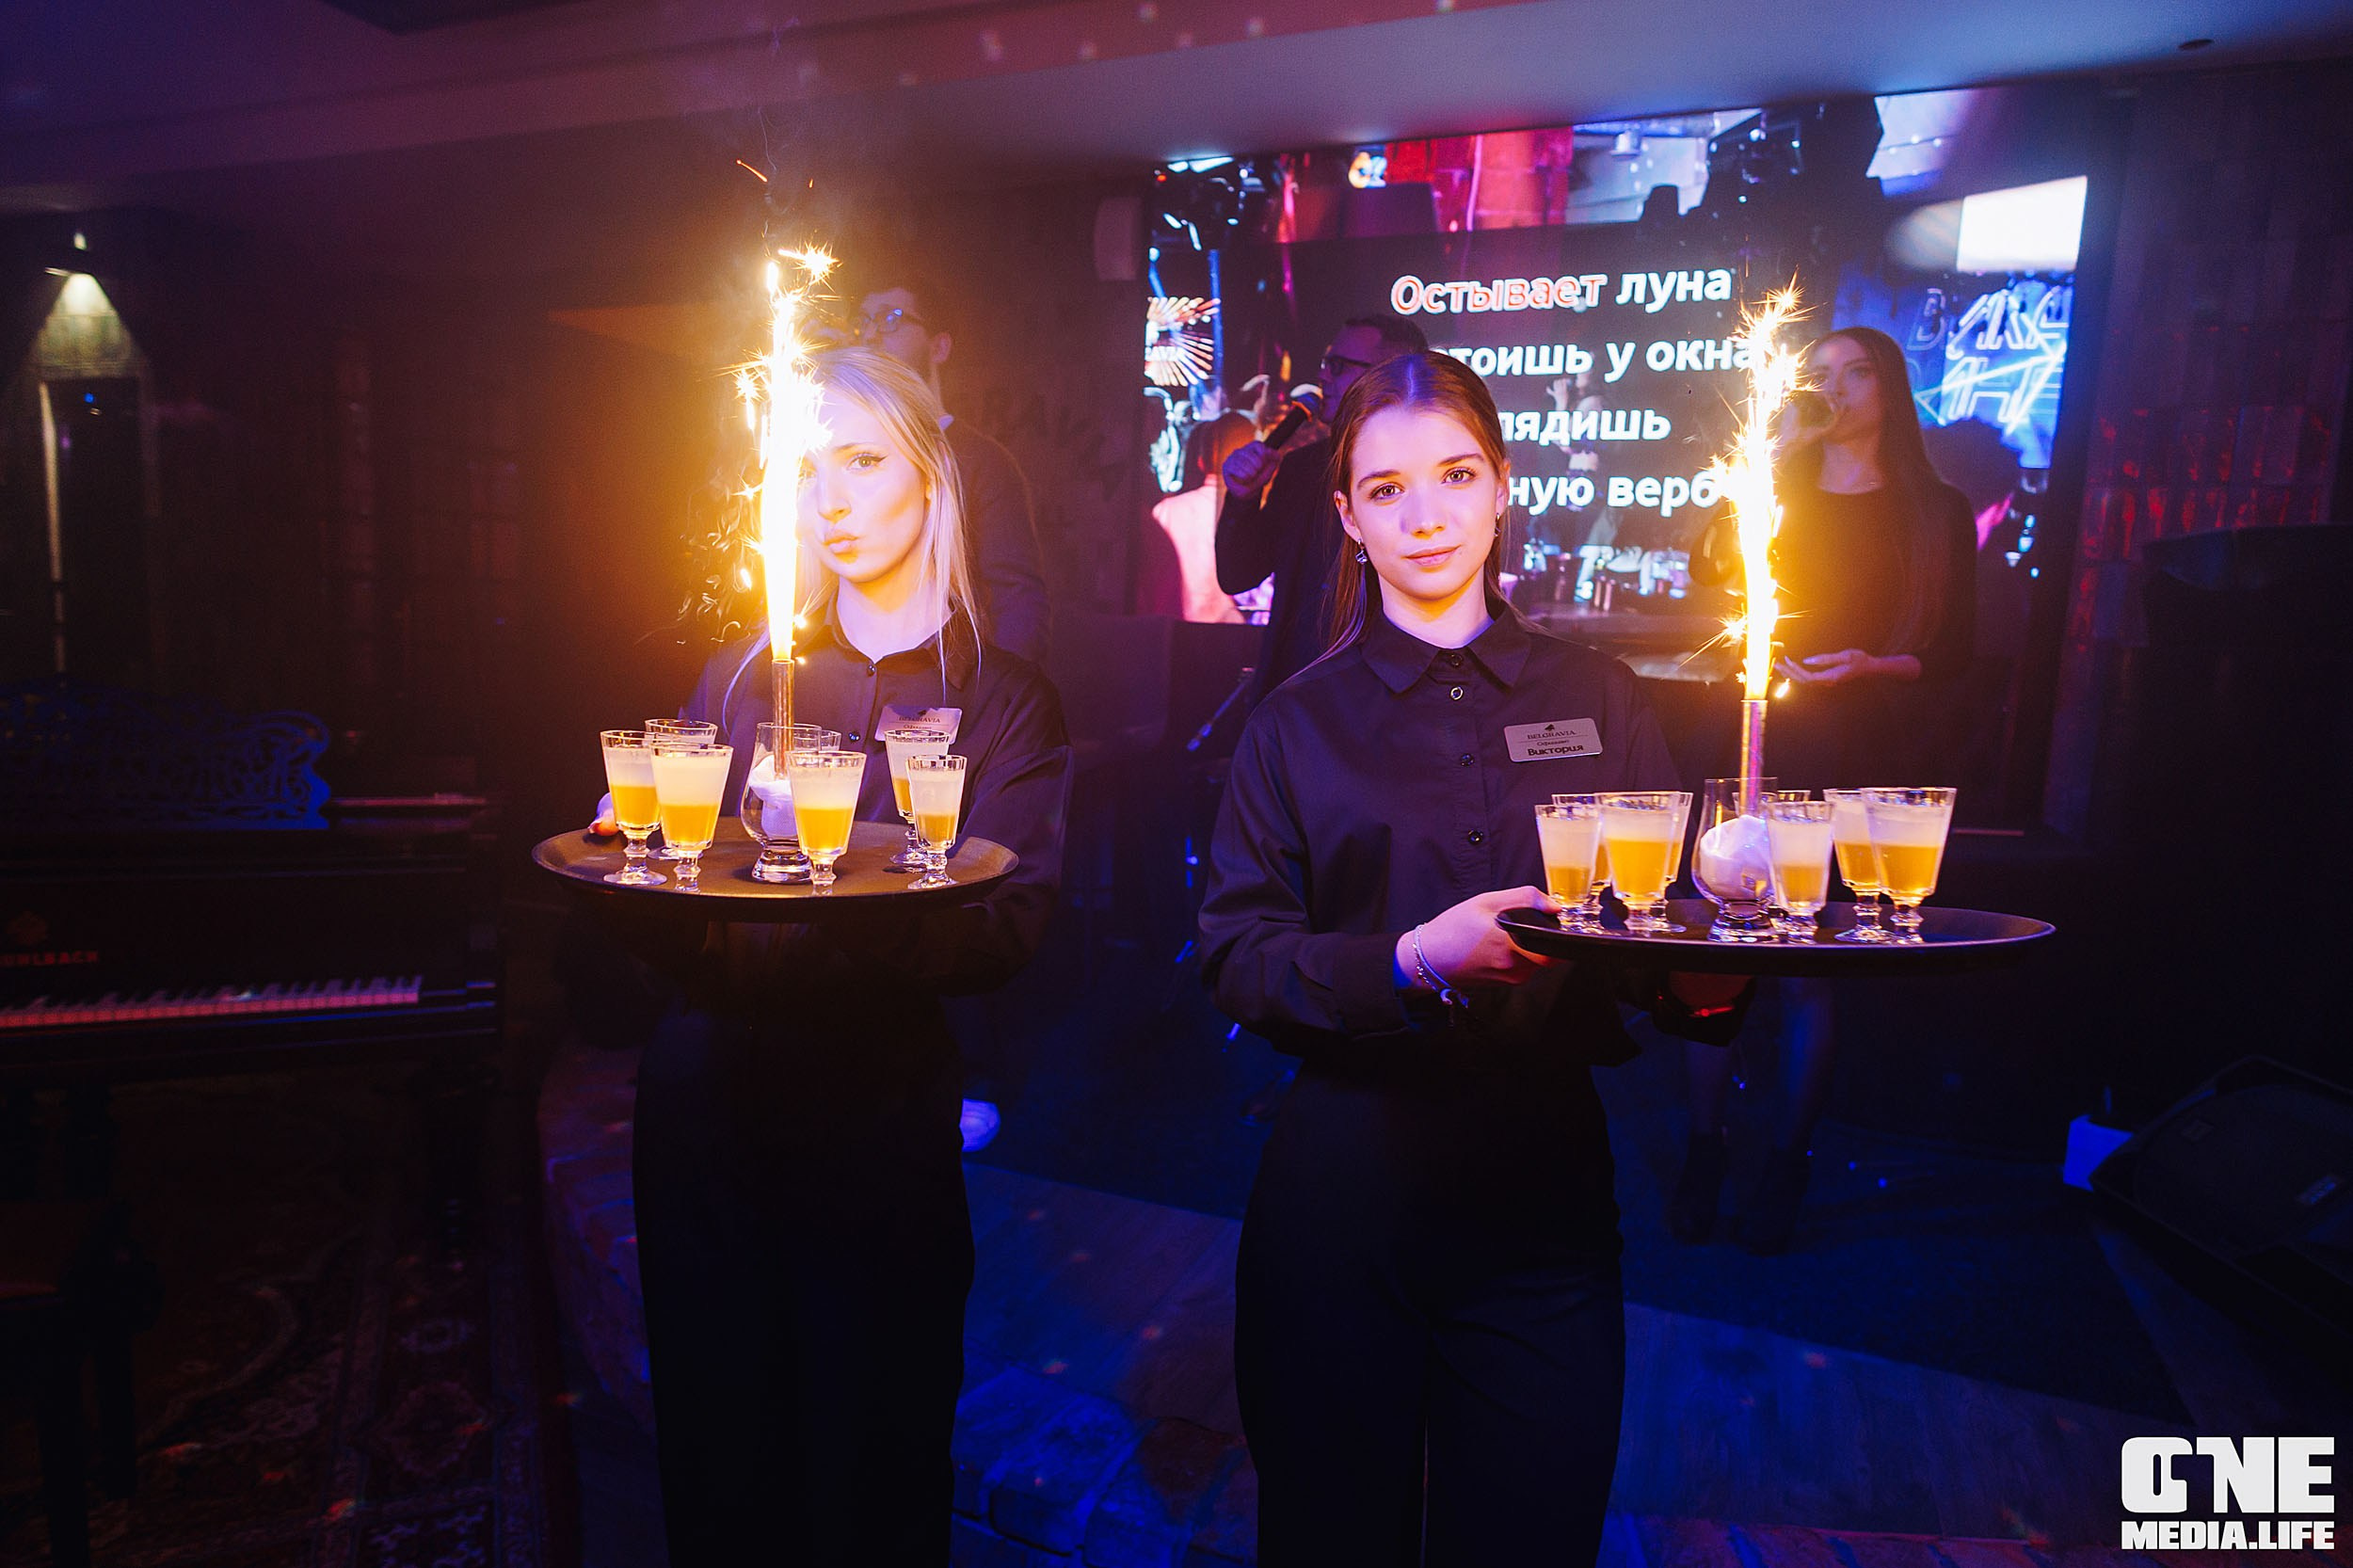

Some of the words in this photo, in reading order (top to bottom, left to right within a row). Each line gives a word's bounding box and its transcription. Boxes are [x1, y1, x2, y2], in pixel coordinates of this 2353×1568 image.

[1390, 273, 1607, 315] Остывает
[1615, 268, 1732, 312] луна
[1429, 345, 1593, 376] тоишь
[1604, 340, 1636, 382] у
[1500, 408, 1671, 446] лядишь
[1508, 475, 1594, 516] ную
[1607, 471, 1719, 517] верб
[1527, 730, 1576, 740] BELGRAVIA
[1527, 744, 1584, 756] Виктория
